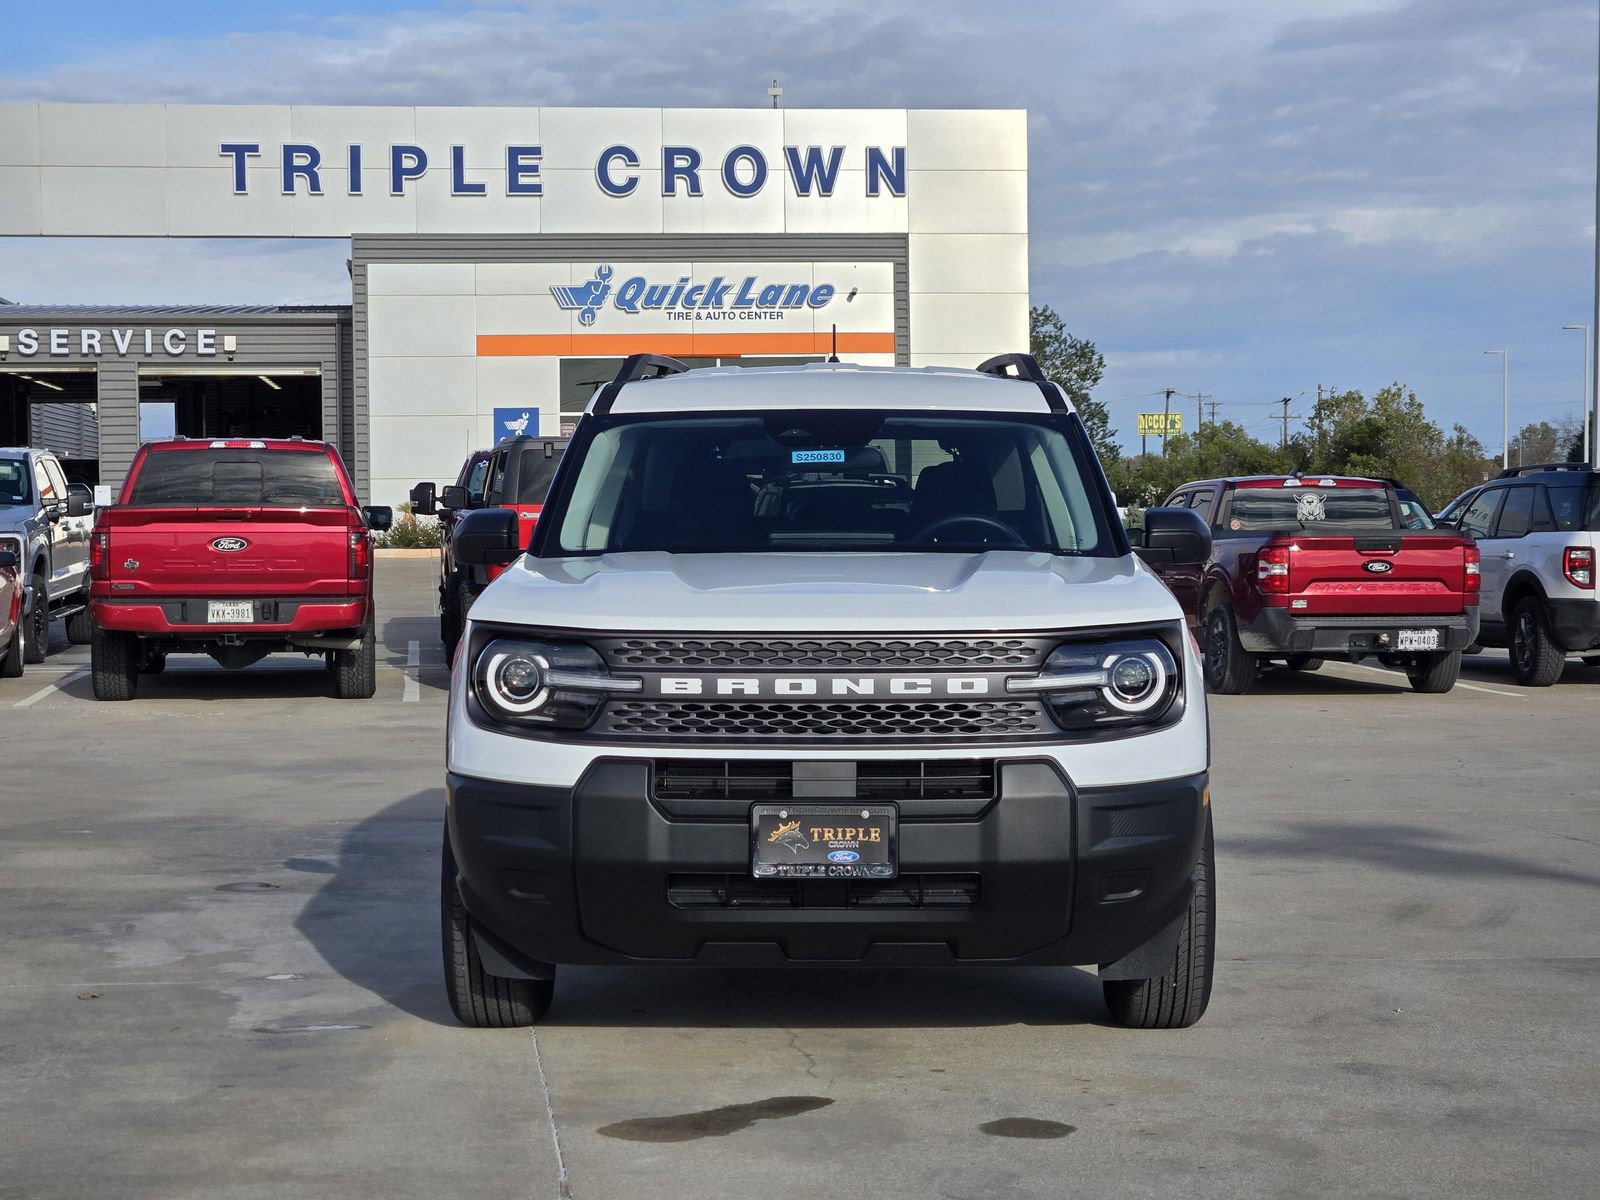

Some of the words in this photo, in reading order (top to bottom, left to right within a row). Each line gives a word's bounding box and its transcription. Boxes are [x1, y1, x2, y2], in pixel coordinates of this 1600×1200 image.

[219, 143, 544, 196] TRIPLE
[594, 143, 908, 198] CROWN
[614, 276, 735, 312] Quick
[731, 275, 837, 309] Lane
[666, 311, 692, 320] TIRE
[695, 311, 702, 320] &
[705, 311, 736, 320] AUTO
[739, 311, 784, 320] CENTER
[17, 327, 217, 357] SERVICE
[796, 452, 842, 461] S250830
[216, 539, 243, 550] Ford
[1314, 583, 1440, 592] MAVERICK
[660, 677, 989, 695] BRONCO
[810, 828, 881, 842] TRIPLE
[832, 852, 855, 861] Ford
[777, 866, 826, 877] TRIPLE
[828, 866, 871, 877] CROWN
